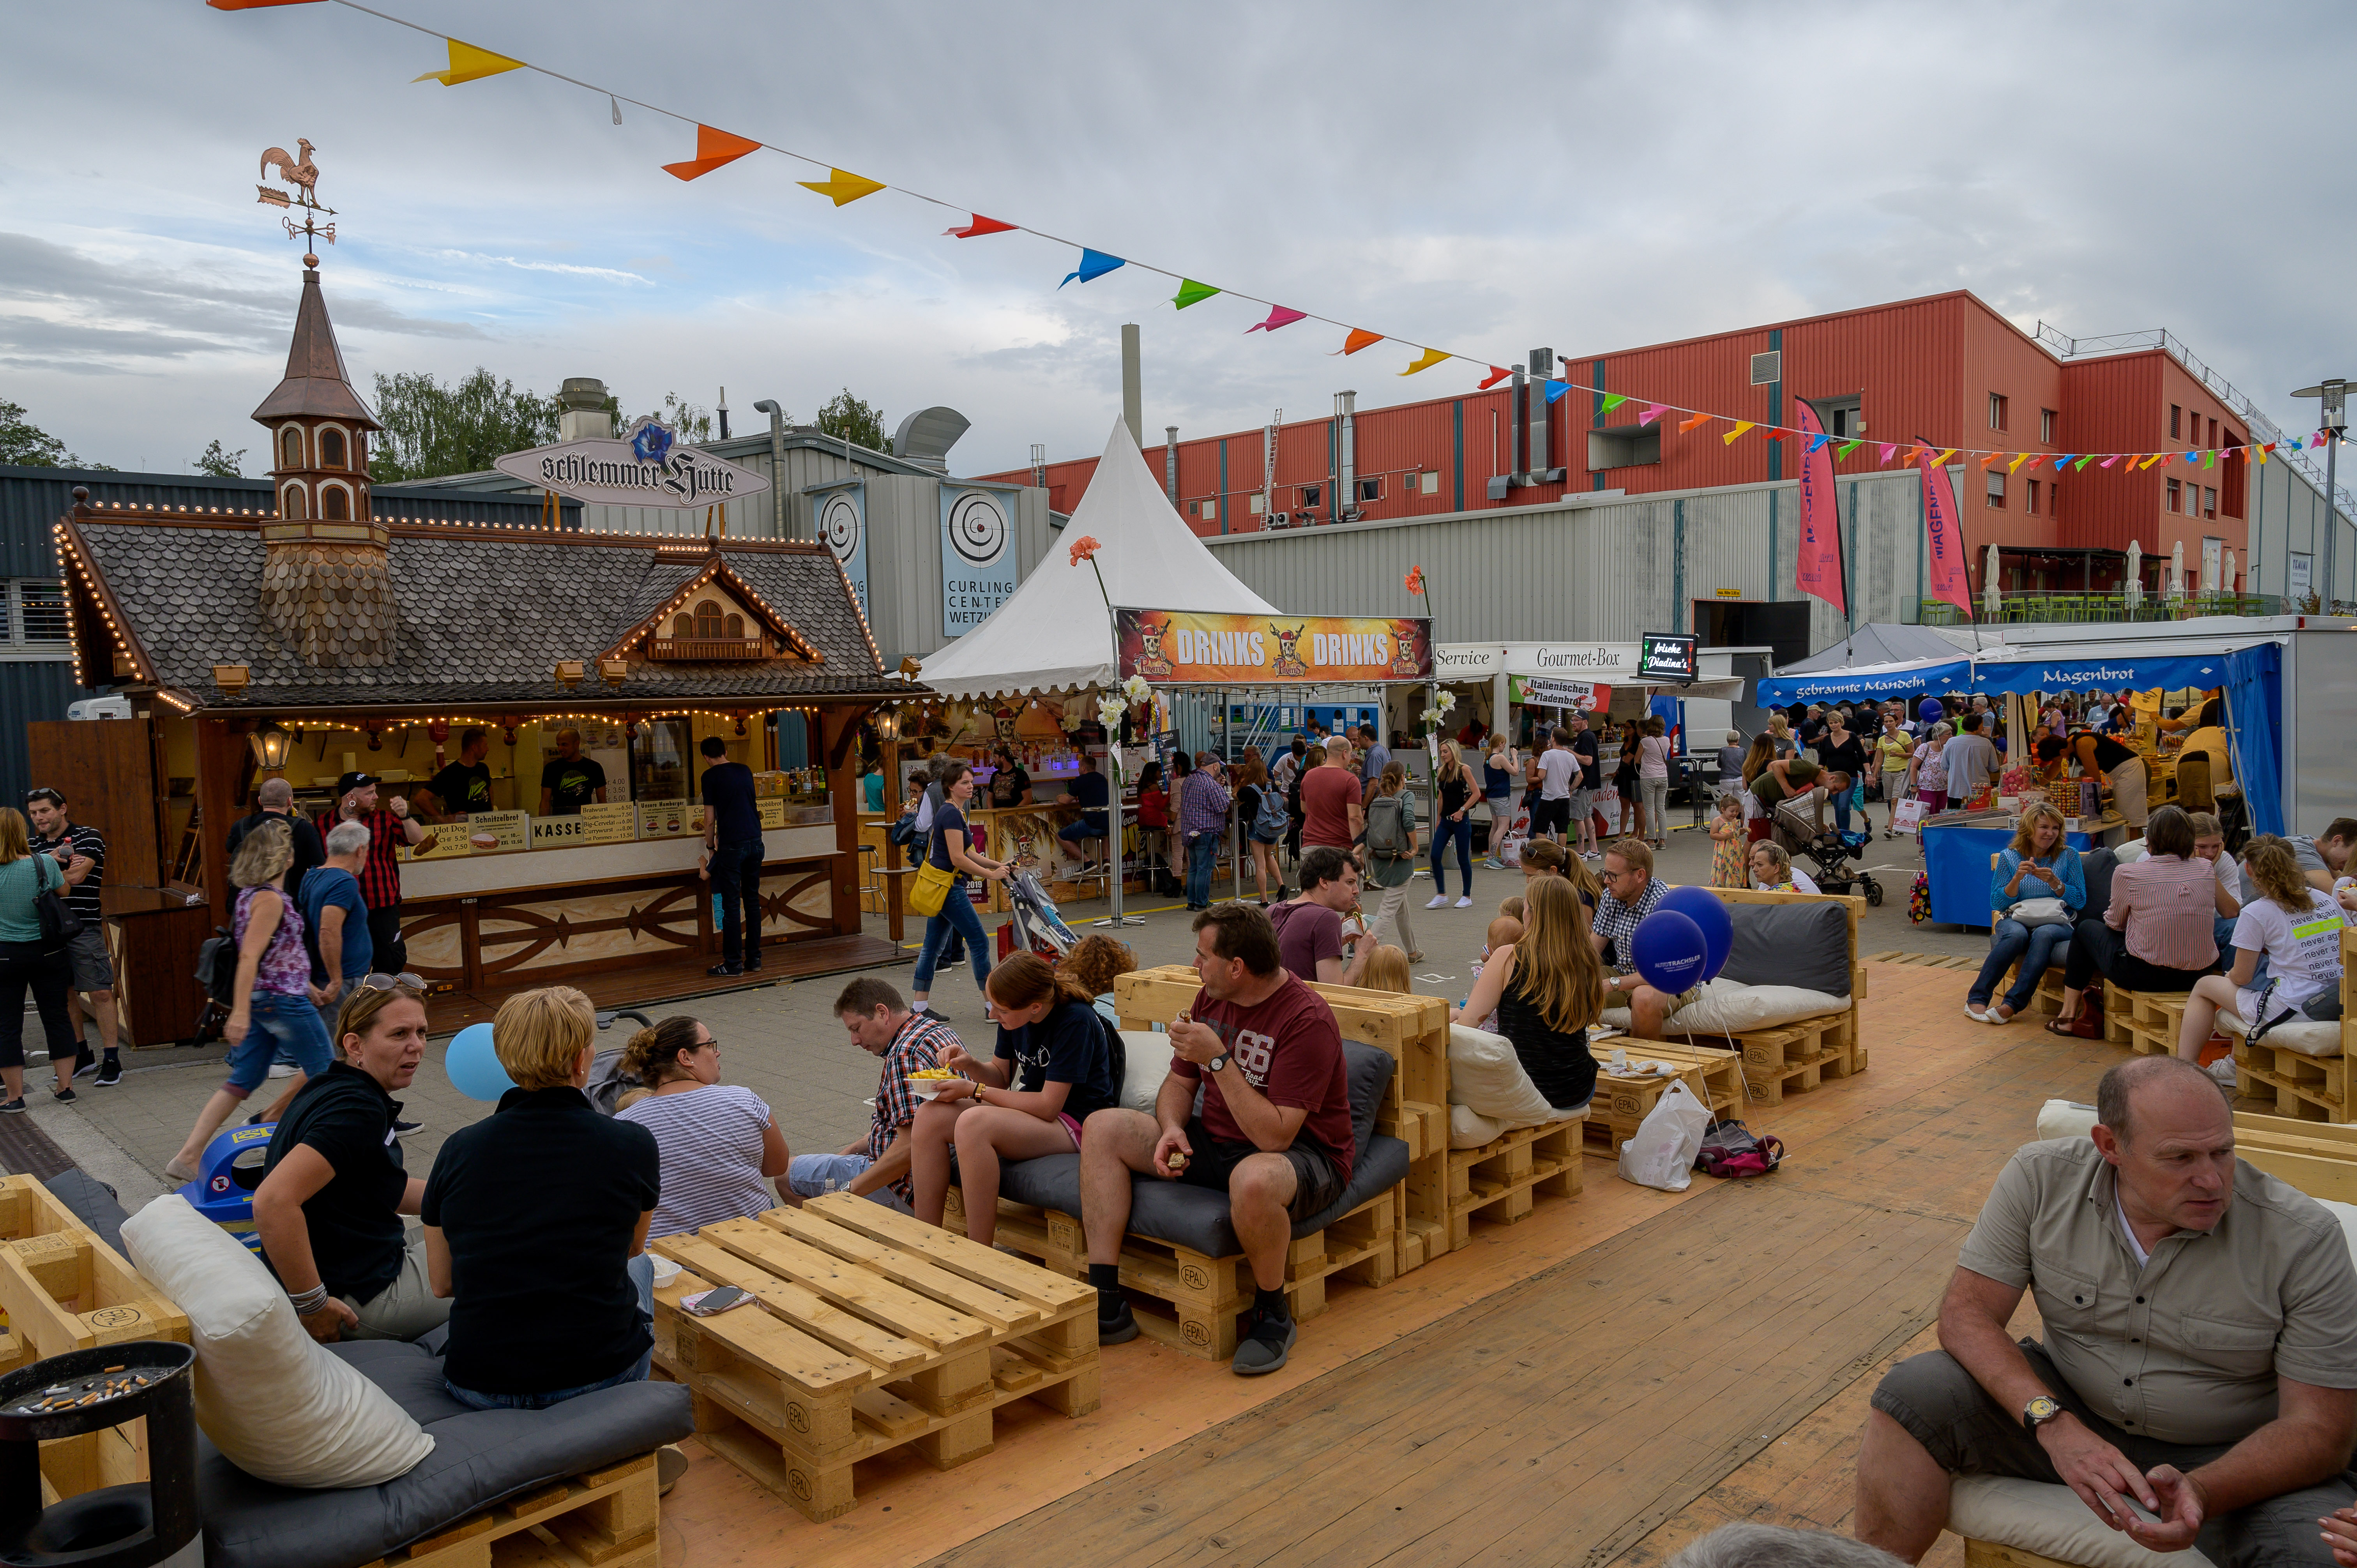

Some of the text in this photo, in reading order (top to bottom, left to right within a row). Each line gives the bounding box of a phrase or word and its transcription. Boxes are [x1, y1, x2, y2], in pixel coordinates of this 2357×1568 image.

[664, 452, 735, 505] Hütte
[949, 581, 1012, 593] CURLING
[949, 596, 1009, 607] CENTE
[949, 611, 991, 623] WETZI
[1177, 629, 1265, 666] DRINKS
[1313, 633, 1388, 666] DRINKS
[1655, 642, 1682, 654] frische
[1436, 650, 1490, 665] Service
[1537, 648, 1620, 667] Gourmet-Box
[1647, 656, 1687, 668] Piadina's
[1139, 656, 1167, 675] PIRATES
[1277, 659, 1301, 676] PIRATES
[1396, 659, 1415, 675] PIRATES
[2043, 666, 2135, 685] Magenbrot
[1530, 679, 1590, 694] Italienisches
[1796, 676, 1926, 699] gebrannte Mandeln
[1534, 692, 1582, 706] Fladenbrot
[475, 814, 519, 824] Schnitzelbrot
[534, 822, 581, 838] KASSE
[2313, 899, 2332, 911] gain
[2290, 908, 2339, 926] never again
[2295, 924, 2320, 936] never
[2300, 936, 2325, 948] never
[2304, 947, 2328, 959] never
[2308, 959, 2333, 971] never
[2311, 968, 2338, 980] never
[1235, 1029, 1275, 1073] 66
[1749, 1052, 1766, 1060] EPAL
[1246, 1070, 1264, 1081] Road
[1246, 1075, 1259, 1087] trip
[1749, 1087, 1765, 1096] EPAL
[1618, 1099, 1637, 1109] EPAL
[1184, 1270, 1205, 1286] EPAL
[99, 1309, 132, 1326] EPAL
[1186, 1325, 1207, 1342] EPAL
[788, 1406, 807, 1430] EPAL
[792, 1474, 810, 1497] EPAL
